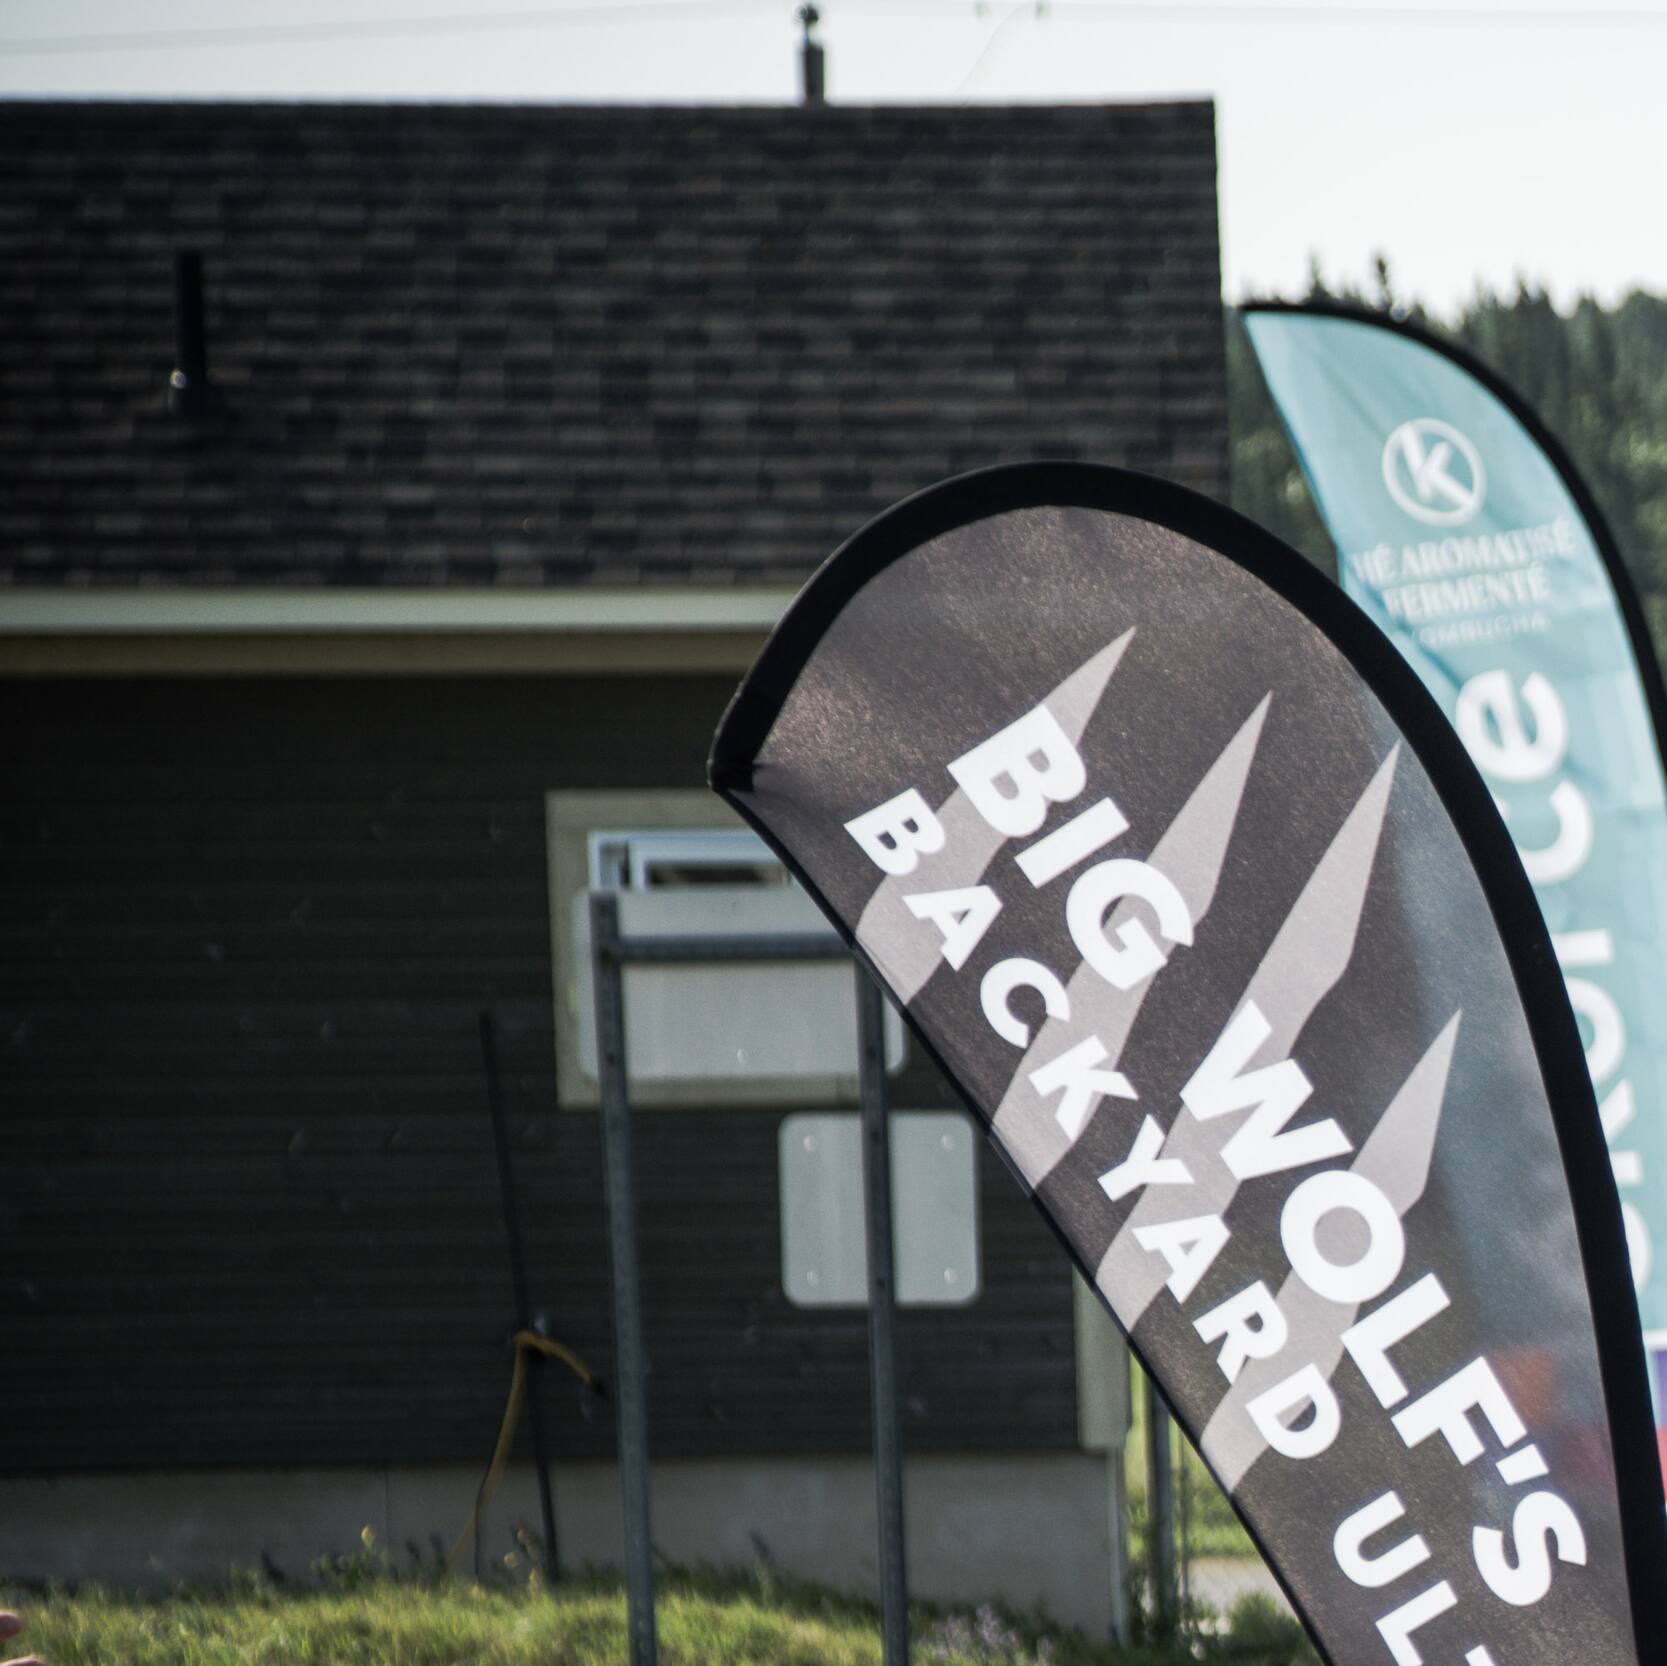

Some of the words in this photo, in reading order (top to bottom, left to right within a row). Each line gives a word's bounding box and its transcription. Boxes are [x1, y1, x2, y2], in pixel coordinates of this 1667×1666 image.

[843, 787, 1341, 1460] BACKYARD
[945, 702, 1194, 992] BIG
[1178, 998, 1587, 1607] WOLF'S
